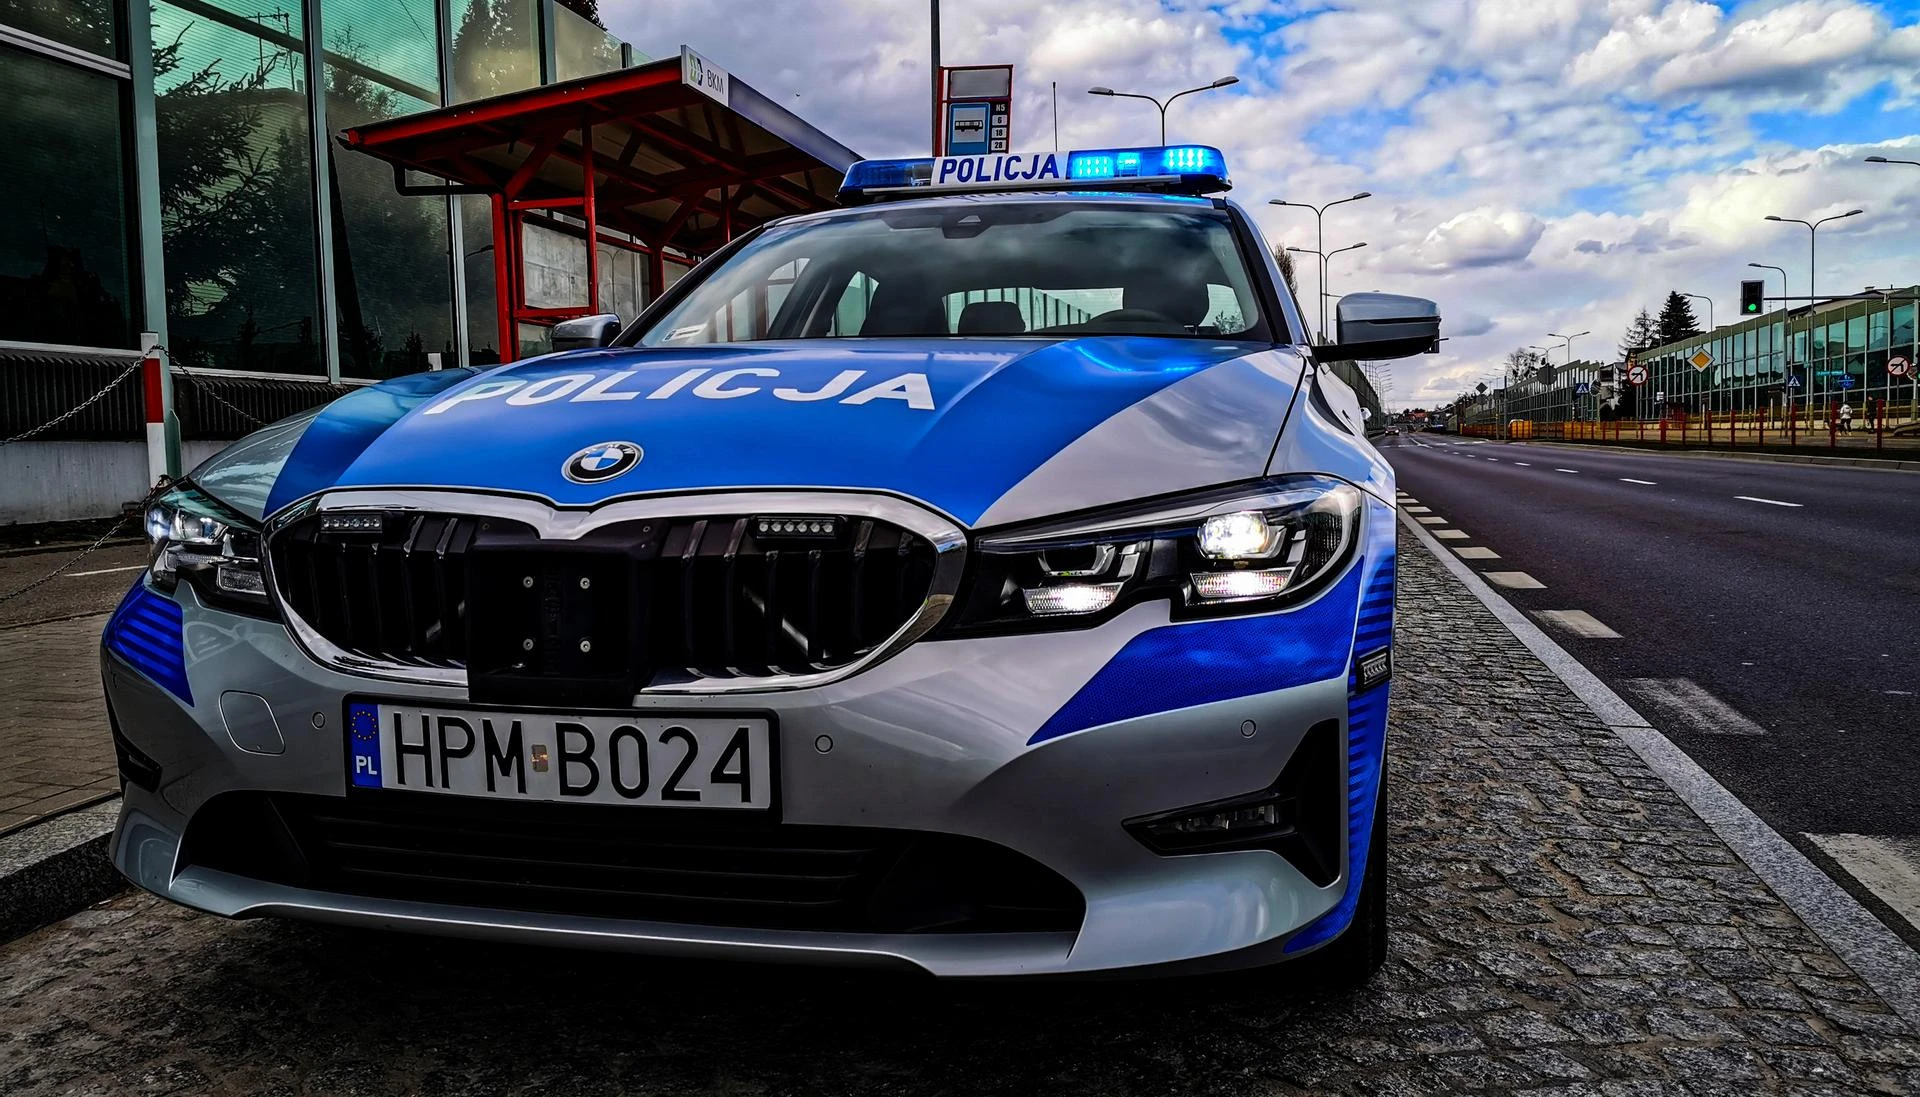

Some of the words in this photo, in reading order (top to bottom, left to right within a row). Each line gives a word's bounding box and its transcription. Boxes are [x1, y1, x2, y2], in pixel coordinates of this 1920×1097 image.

[707, 69, 724, 95] BKM
[994, 141, 1003, 149] 28
[995, 129, 1003, 137] 18
[939, 153, 1060, 184] POLICJA
[424, 367, 935, 416] POLICJA
[355, 755, 378, 777] PL
[393, 712, 528, 794] HPM
[555, 722, 752, 803] B024
